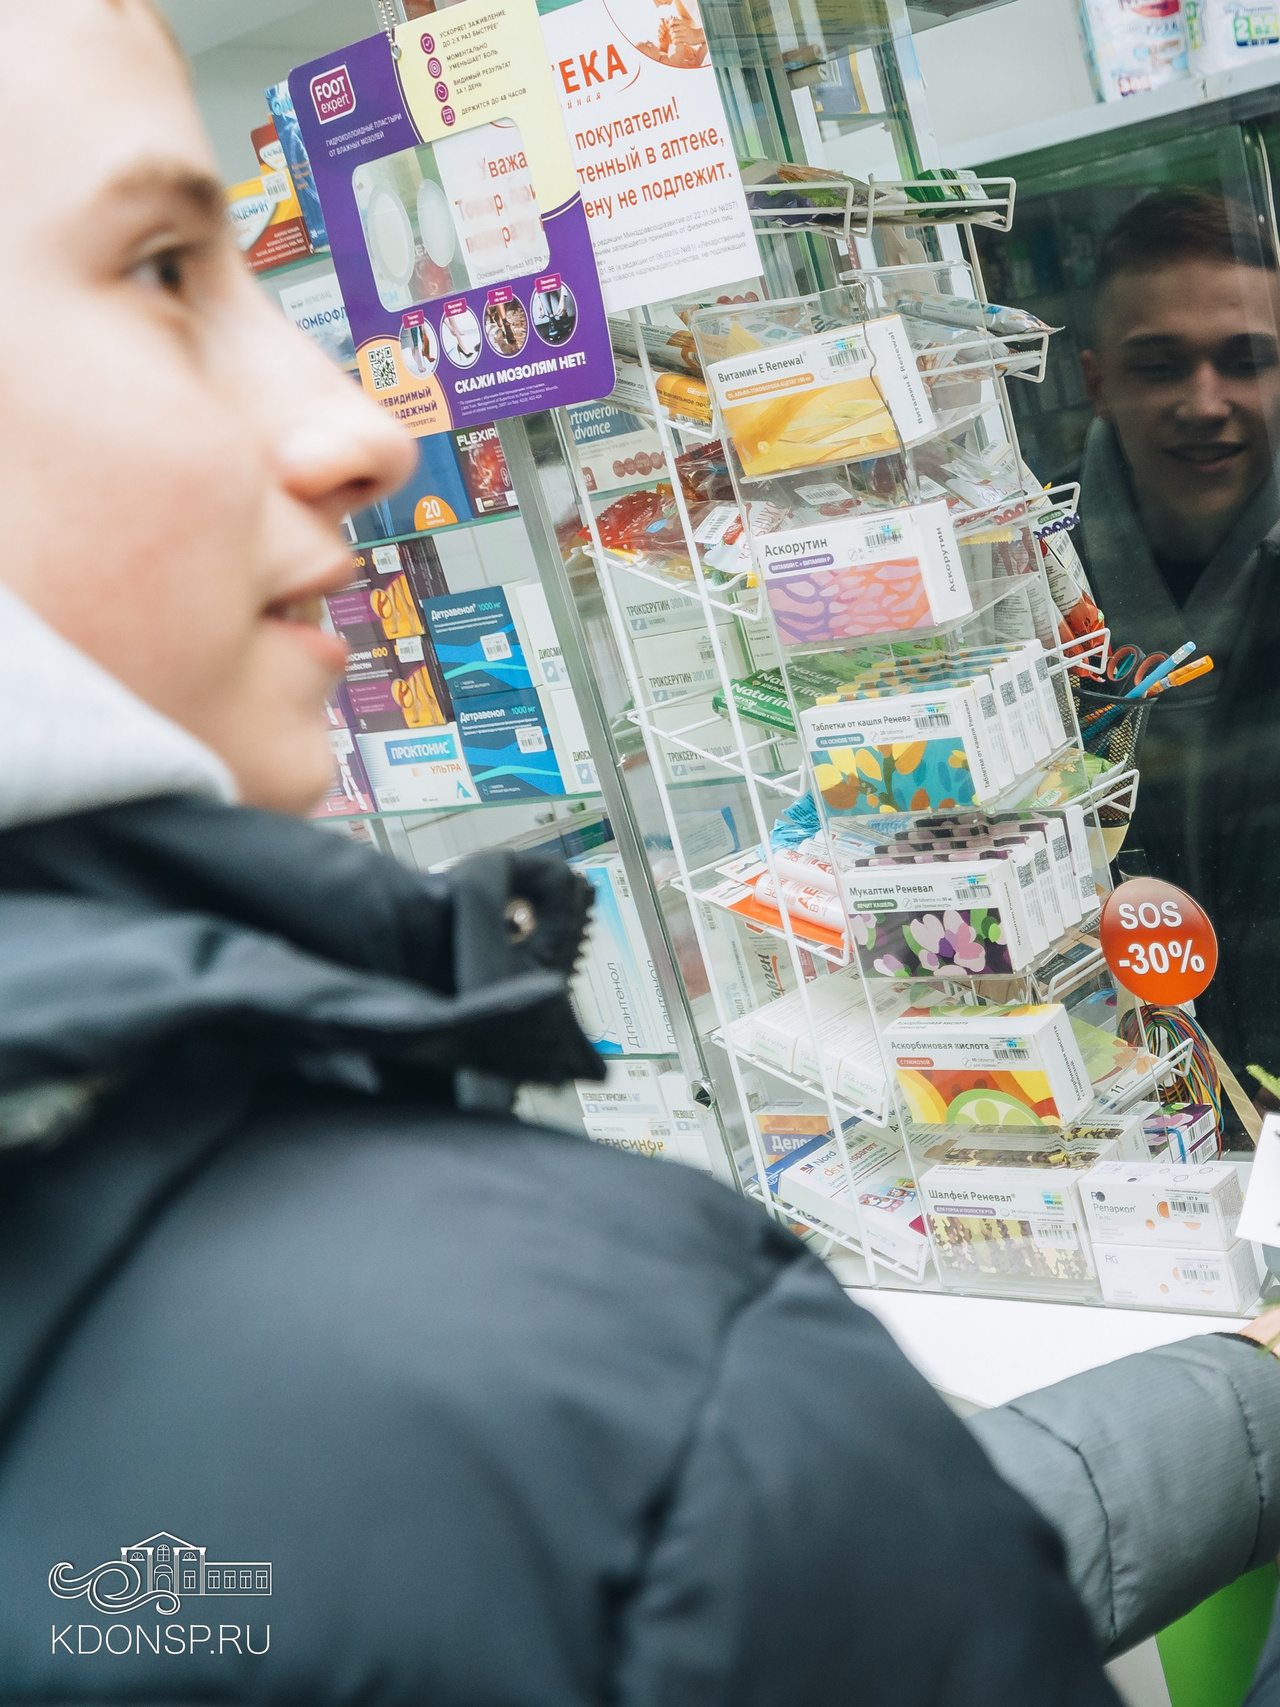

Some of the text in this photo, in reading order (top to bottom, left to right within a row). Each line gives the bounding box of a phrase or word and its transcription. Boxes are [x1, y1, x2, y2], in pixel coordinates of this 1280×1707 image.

[439, 9, 506, 39] УСКОРЯЕТ ЗАЖИВЛЕНИЕ
[442, 39, 451, 48] ДО
[446, 42, 488, 61] МОМЕНТАЛЬНО
[449, 49, 499, 71] УМЕНЬШАЕТ БОЛЬ
[551, 43, 628, 94] ЕКА
[453, 61, 511, 86] ВИДИМЫЙ РЕЗУЛЬТАТ
[315, 75, 348, 102] FOOT
[321, 93, 350, 114] expert
[461, 99, 491, 116] ДЕРЖИТСЯ
[508, 87, 527, 100] ЧАСОВ
[325, 112, 403, 147] ГИДРОКОЛЛОИДНЫЕ ПЛАСТЫРИ
[575, 96, 680, 150] покупатели!
[336, 140, 363, 156] ВЛАЖНЫХ
[362, 130, 385, 146] МОЗОЛЕЙ
[645, 147, 657, 165] в
[661, 127, 725, 160] аптеке,
[617, 188, 638, 209] не
[641, 162, 733, 202] подлежит.
[455, 352, 587, 394] СКАЖИ МОЗОЛЯМ НЕТ!
[717, 367, 758, 384] Витамин
[391, 400, 438, 420] АДЕЖНЫЙ
[422, 499, 441, 520] 20
[764, 538, 828, 558] Аскорутин
[771, 557, 826, 571] ВИТАМИН ВИТАМИН
[936, 526, 957, 593] Аскорутин
[811, 720, 846, 732] Таблетки
[847, 721, 856, 729] от
[857, 717, 883, 728] кашля
[390, 742, 450, 760] ПРОКТОНИС
[430, 763, 463, 775] УЛЬТРА
[849, 884, 934, 898] Мукалтин Реневал
[1118, 901, 1183, 930] SOS
[1118, 939, 1205, 974] -30%
[891, 1041, 989, 1051] Аскорбиновая кислота
[812, 1150, 837, 1167] Nord
[928, 1189, 969, 1202] Шалфей
[1093, 1204, 1136, 1213] Репаркол
